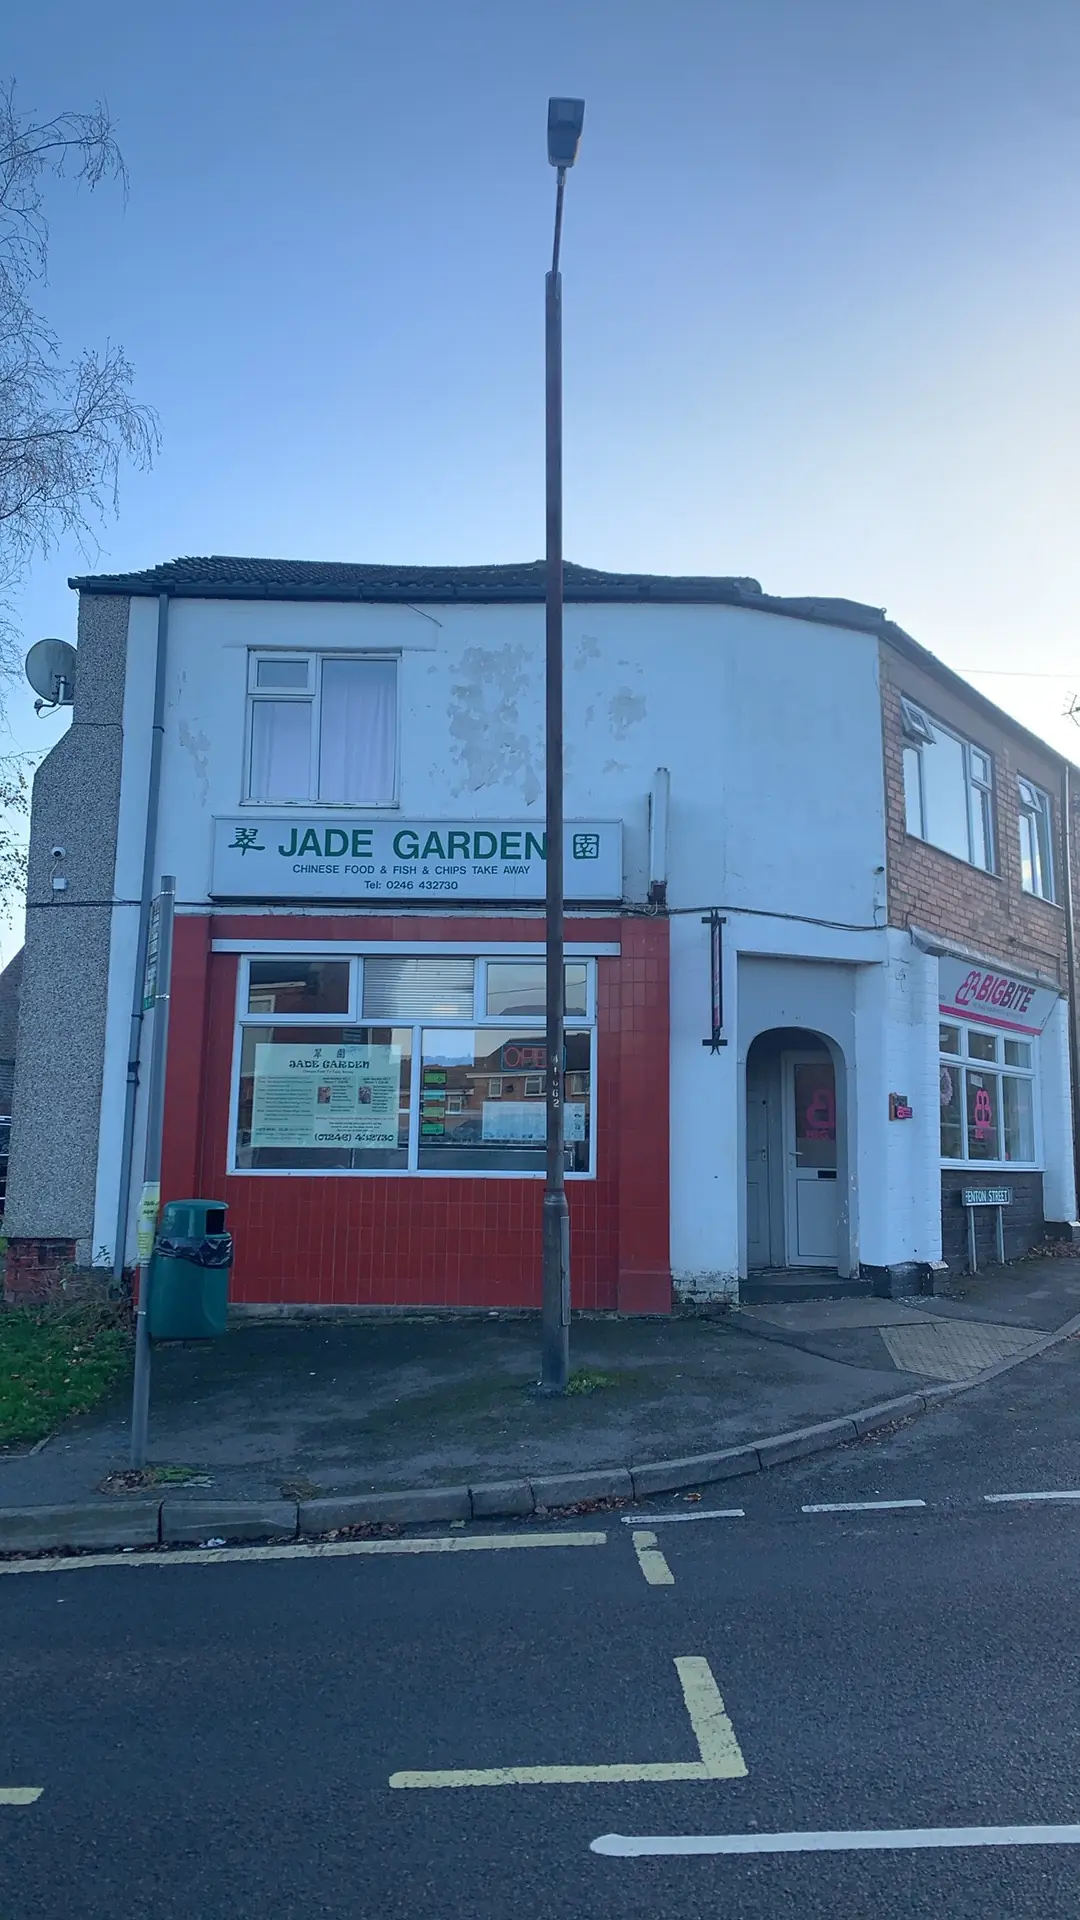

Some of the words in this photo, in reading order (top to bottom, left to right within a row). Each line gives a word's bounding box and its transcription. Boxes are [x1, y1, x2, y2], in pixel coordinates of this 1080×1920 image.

[278, 828, 374, 858] JADE
[392, 830, 547, 860] GARDEN
[292, 864, 340, 874] CHINESE
[344, 865, 375, 875] FOOD
[380, 865, 388, 874] &
[393, 865, 417, 875] FISH
[422, 866, 430, 875] &
[435, 865, 467, 875] CHIPS
[472, 866, 499, 875] TAKE
[503, 866, 531, 875] AWAY
[364, 880, 382, 889] Tel:
[386, 880, 414, 890] 0246
[418, 880, 459, 890] 432730
[974, 974, 1037, 1013] BIGBITE
[504, 1046, 547, 1068] OPE
[289, 1060, 320, 1069] JADE
[322, 1060, 371, 1069] GARDEN
[988, 1189, 1008, 1202] STREET
